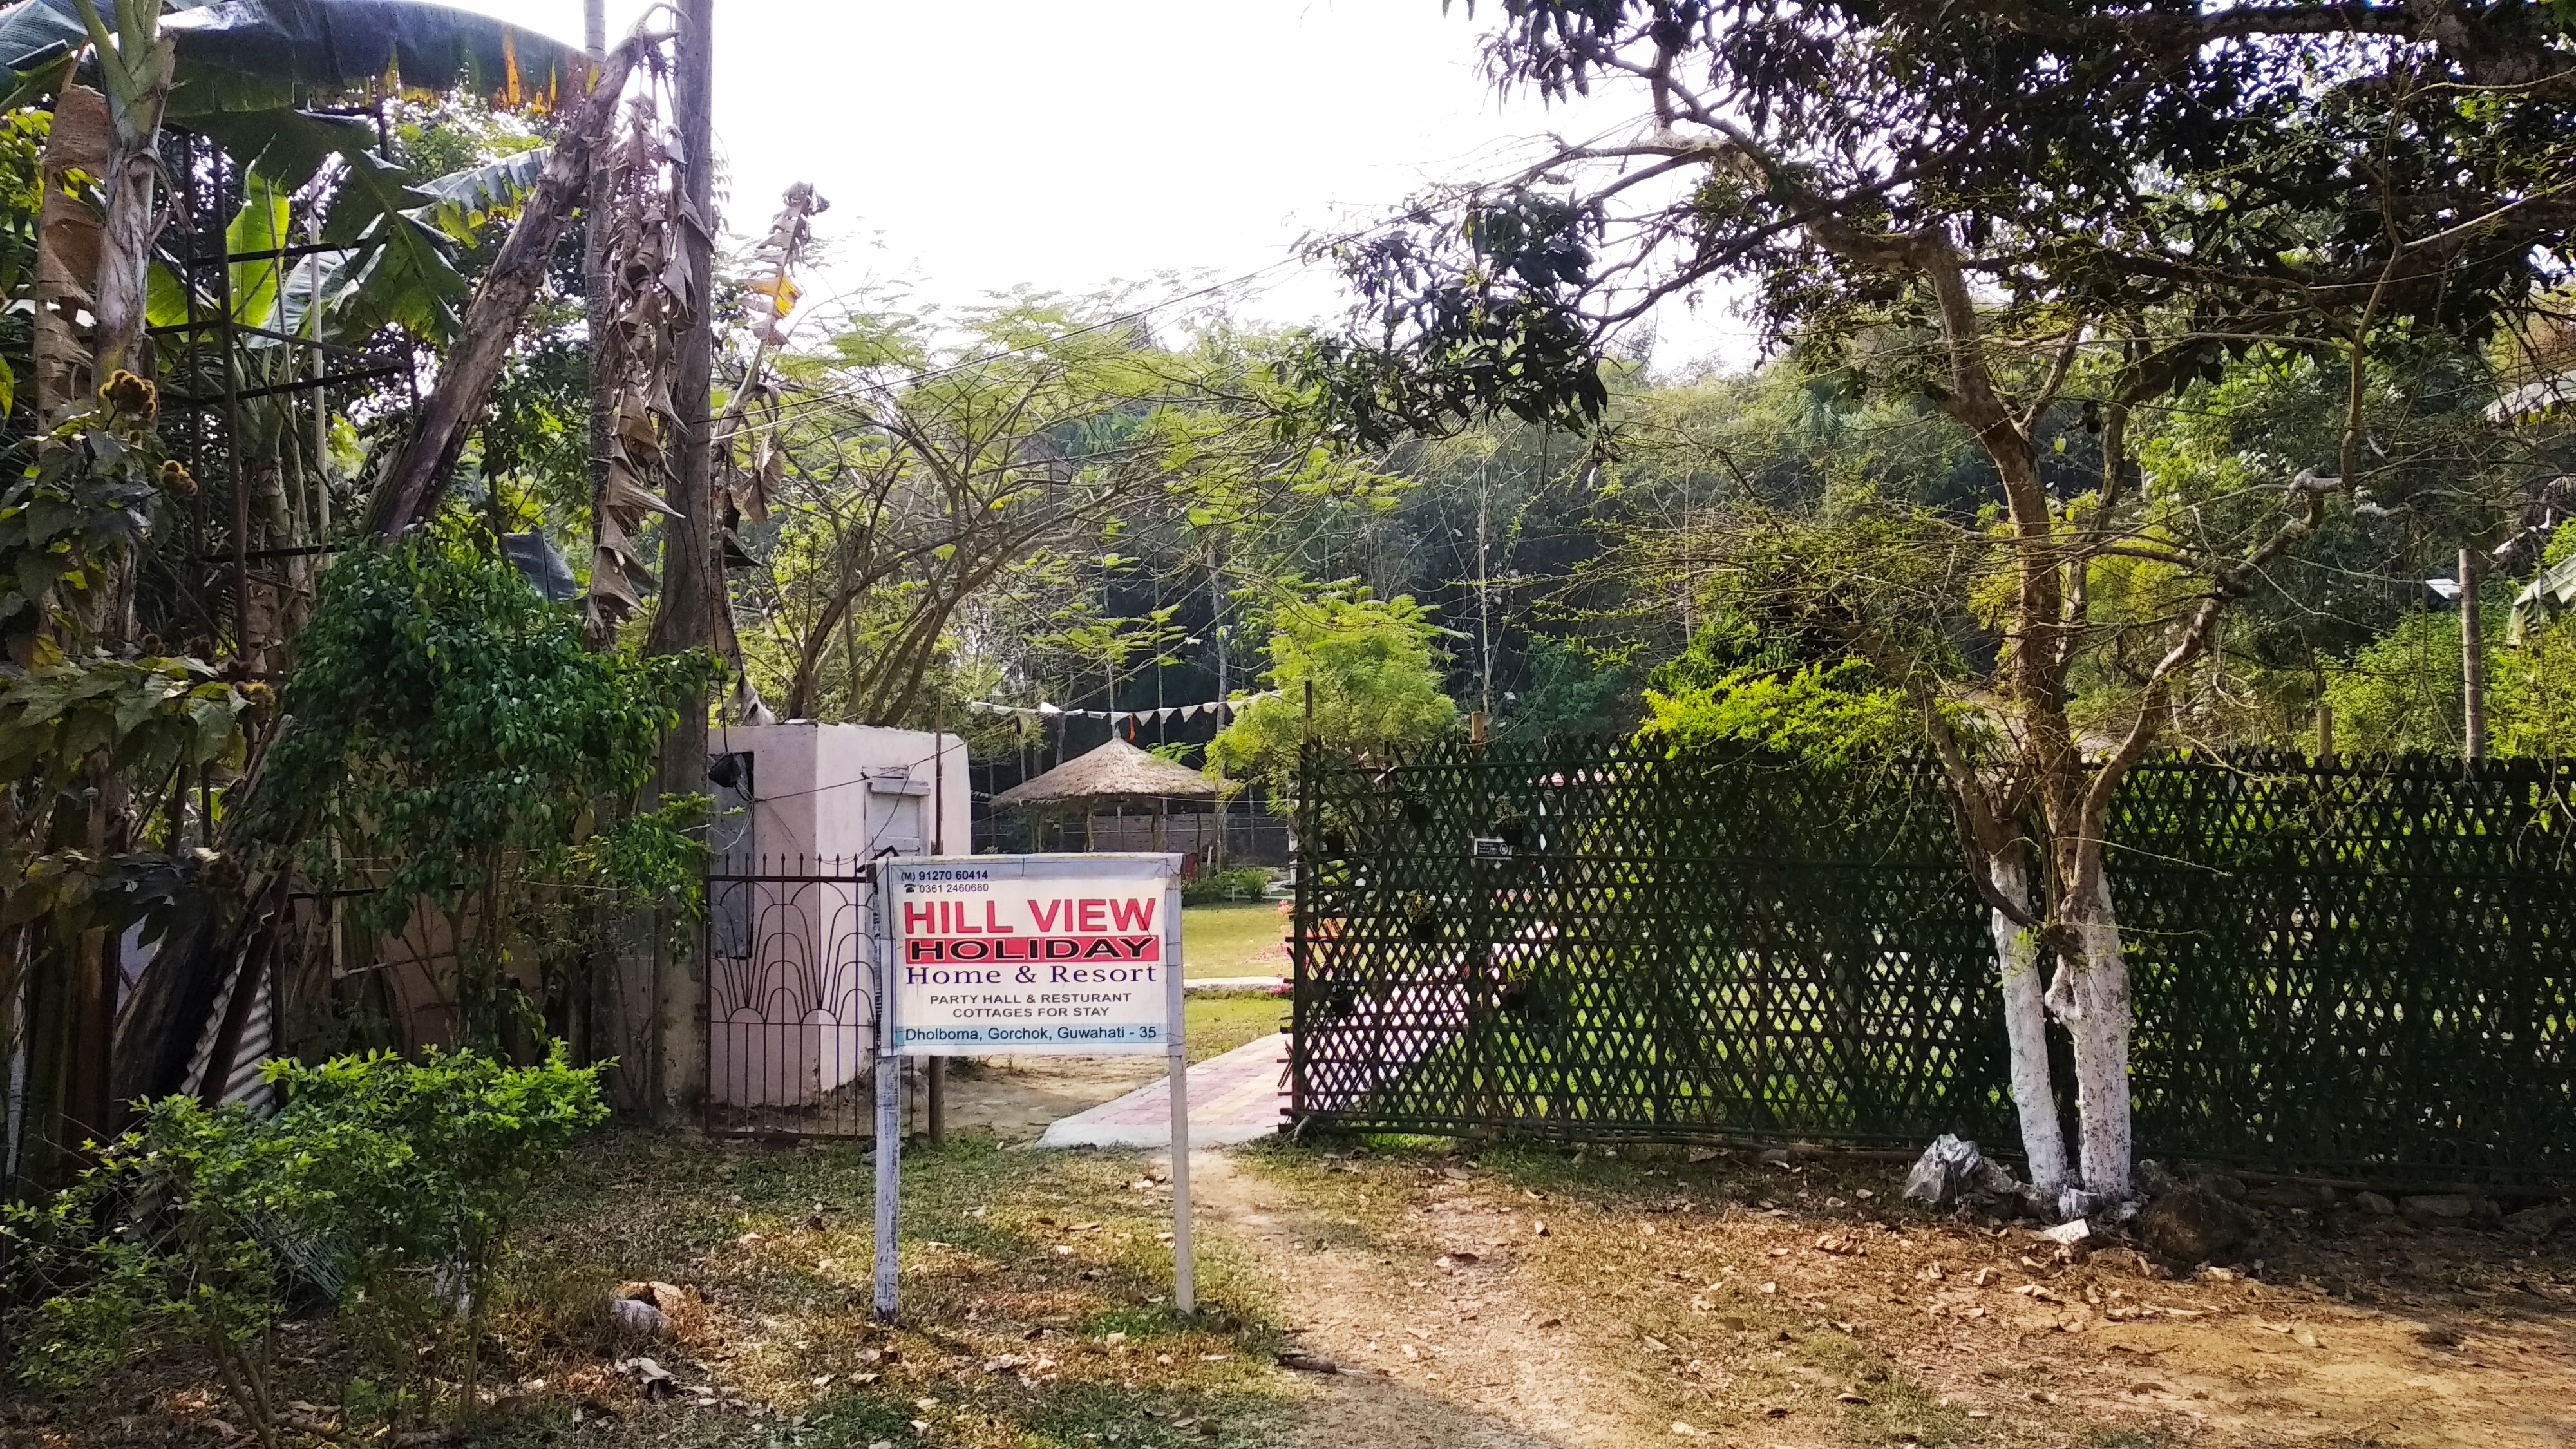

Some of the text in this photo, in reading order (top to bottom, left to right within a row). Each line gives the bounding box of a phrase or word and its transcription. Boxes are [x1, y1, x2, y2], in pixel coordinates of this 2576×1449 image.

[901, 870, 988, 882] (M) 91270 60414
[919, 884, 989, 893] 0361 2460680
[904, 898, 1156, 933] HILL VIEW
[910, 938, 1155, 961] HOLIDAY
[906, 965, 1157, 985] Home & Resort
[931, 993, 1132, 1005] PARTY HALL & RESTURANT
[953, 1007, 1110, 1018] COTTAGES FOR STAY
[905, 1028, 982, 1042] Dholboma,
[988, 1027, 1052, 1041] Gorchok,
[1057, 1027, 1125, 1039] Guwahati
[1139, 1026, 1157, 1039] 35
